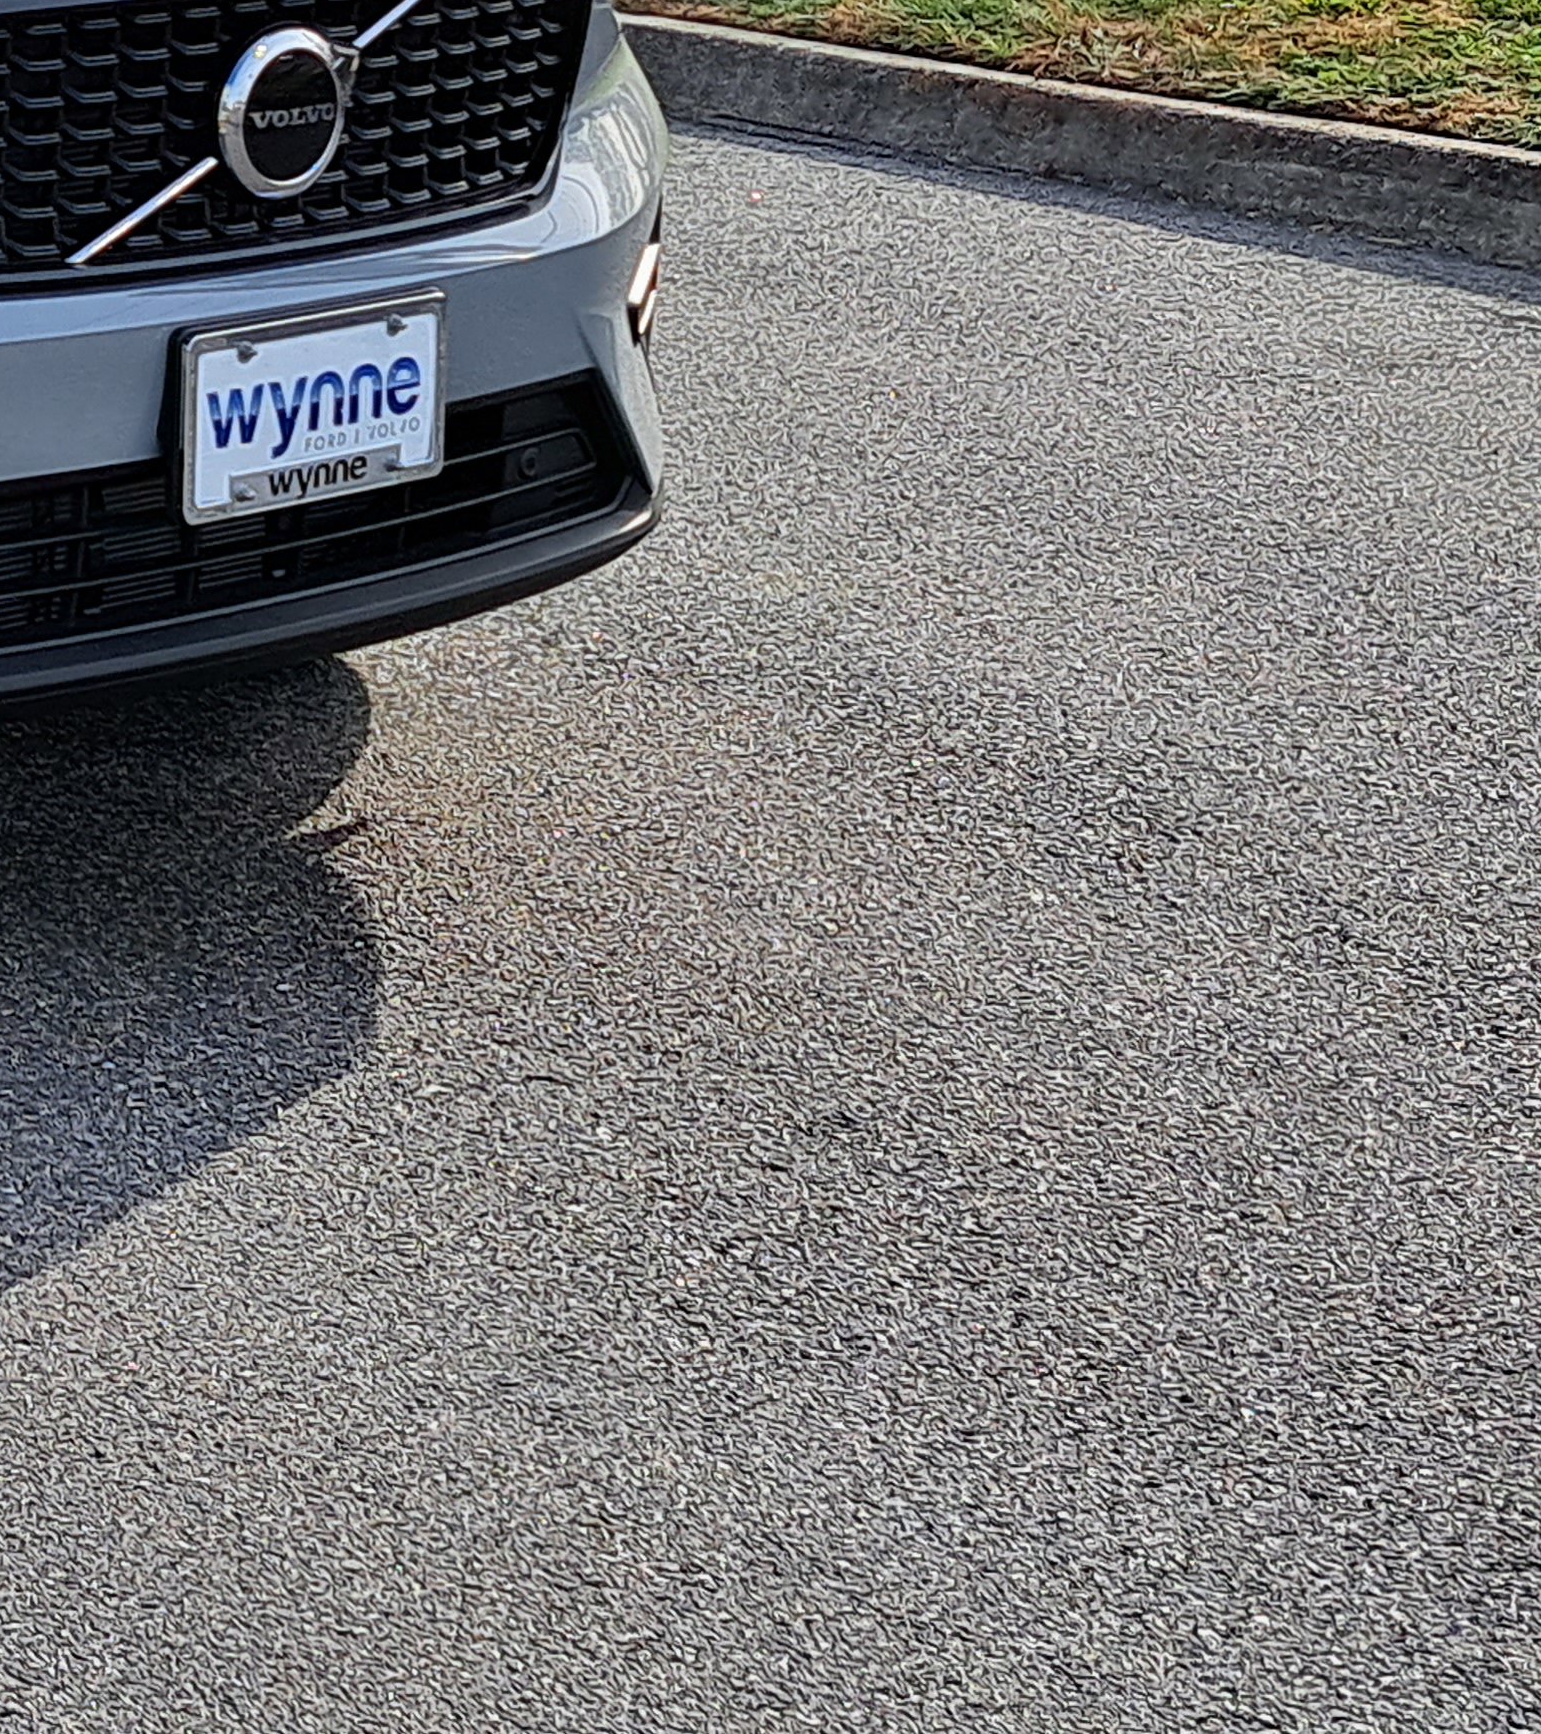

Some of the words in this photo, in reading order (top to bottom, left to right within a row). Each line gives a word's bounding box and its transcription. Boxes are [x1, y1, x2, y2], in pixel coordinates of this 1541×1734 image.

[248, 102, 335, 129] VOLVO
[206, 356, 421, 460] wynne
[304, 427, 347, 453] FORD
[268, 455, 367, 499] wynne
